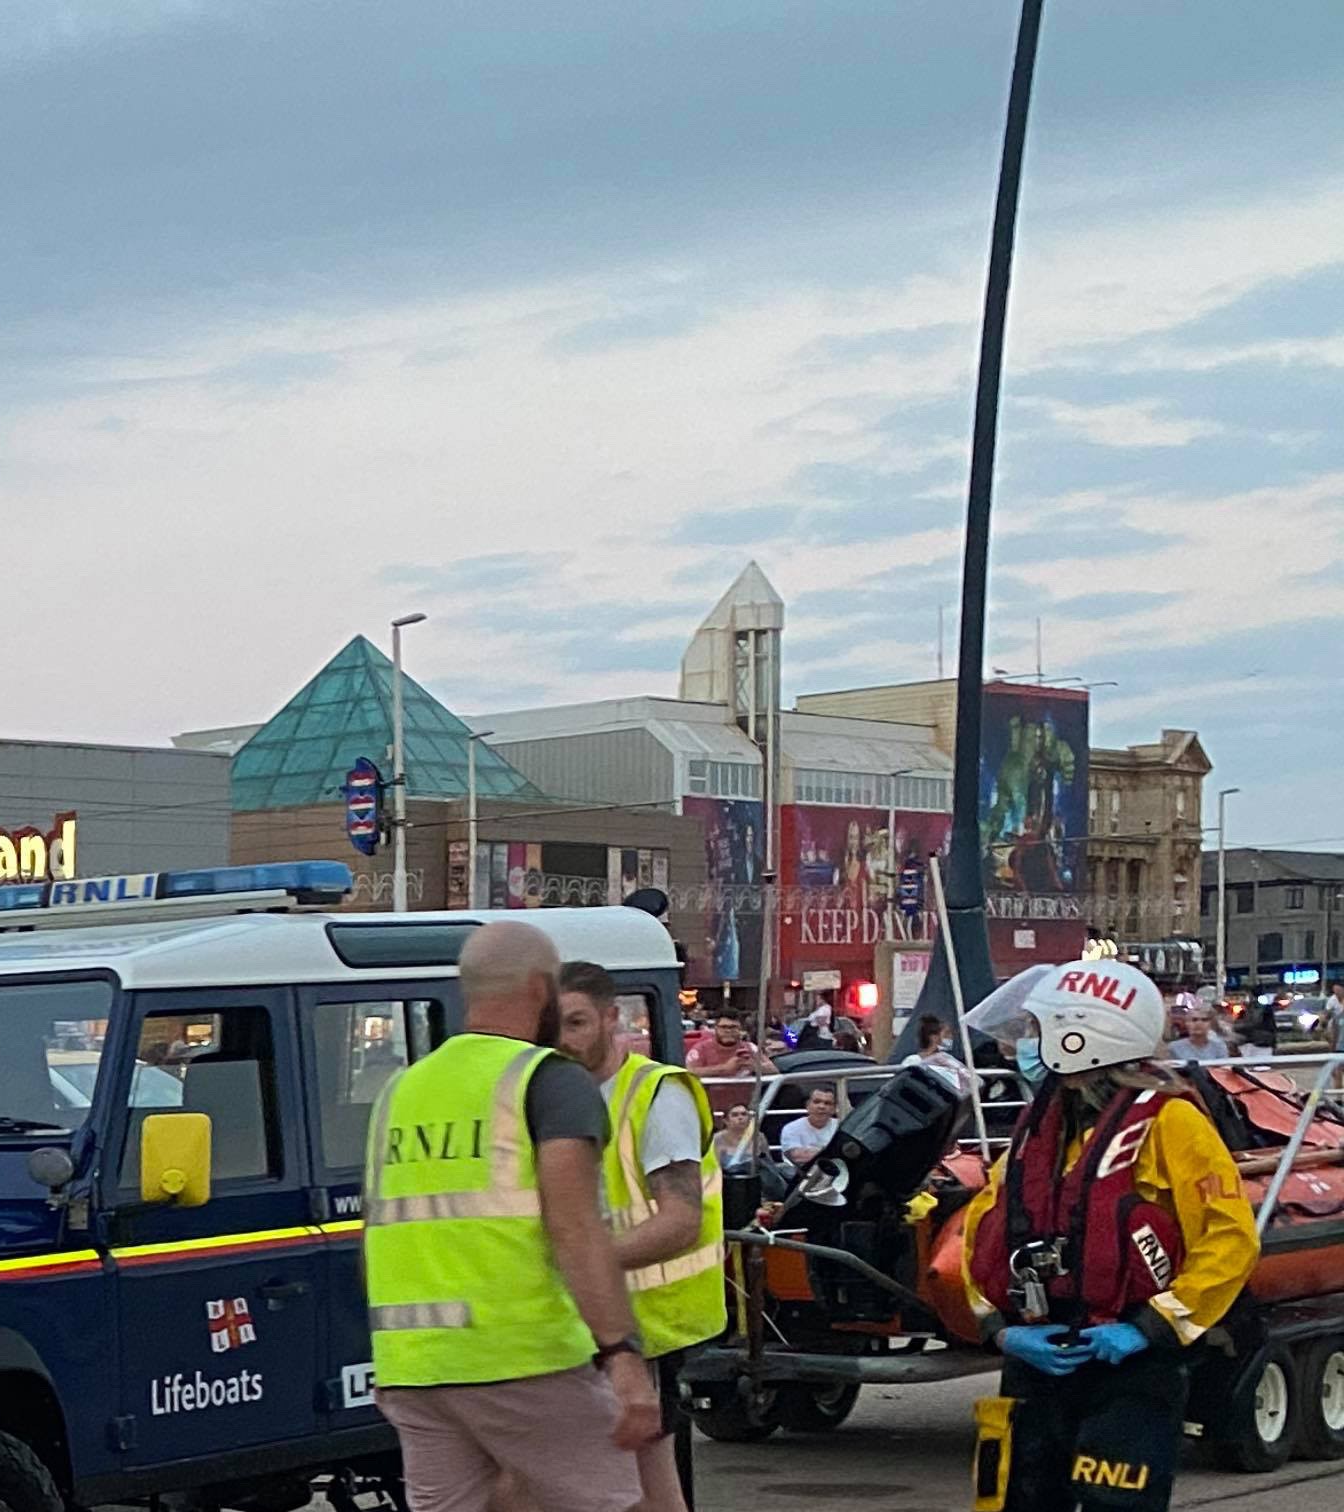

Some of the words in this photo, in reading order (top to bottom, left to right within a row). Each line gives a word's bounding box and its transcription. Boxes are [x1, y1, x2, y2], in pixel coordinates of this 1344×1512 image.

[53, 876, 155, 906] RNLI
[800, 908, 859, 944] KEEP
[1055, 971, 1137, 1011] RNLI
[383, 1119, 483, 1166] RNLI
[1138, 1232, 1172, 1282] RNLI
[151, 1368, 264, 1416] Lifeboats
[1072, 1455, 1150, 1490] RNLI
